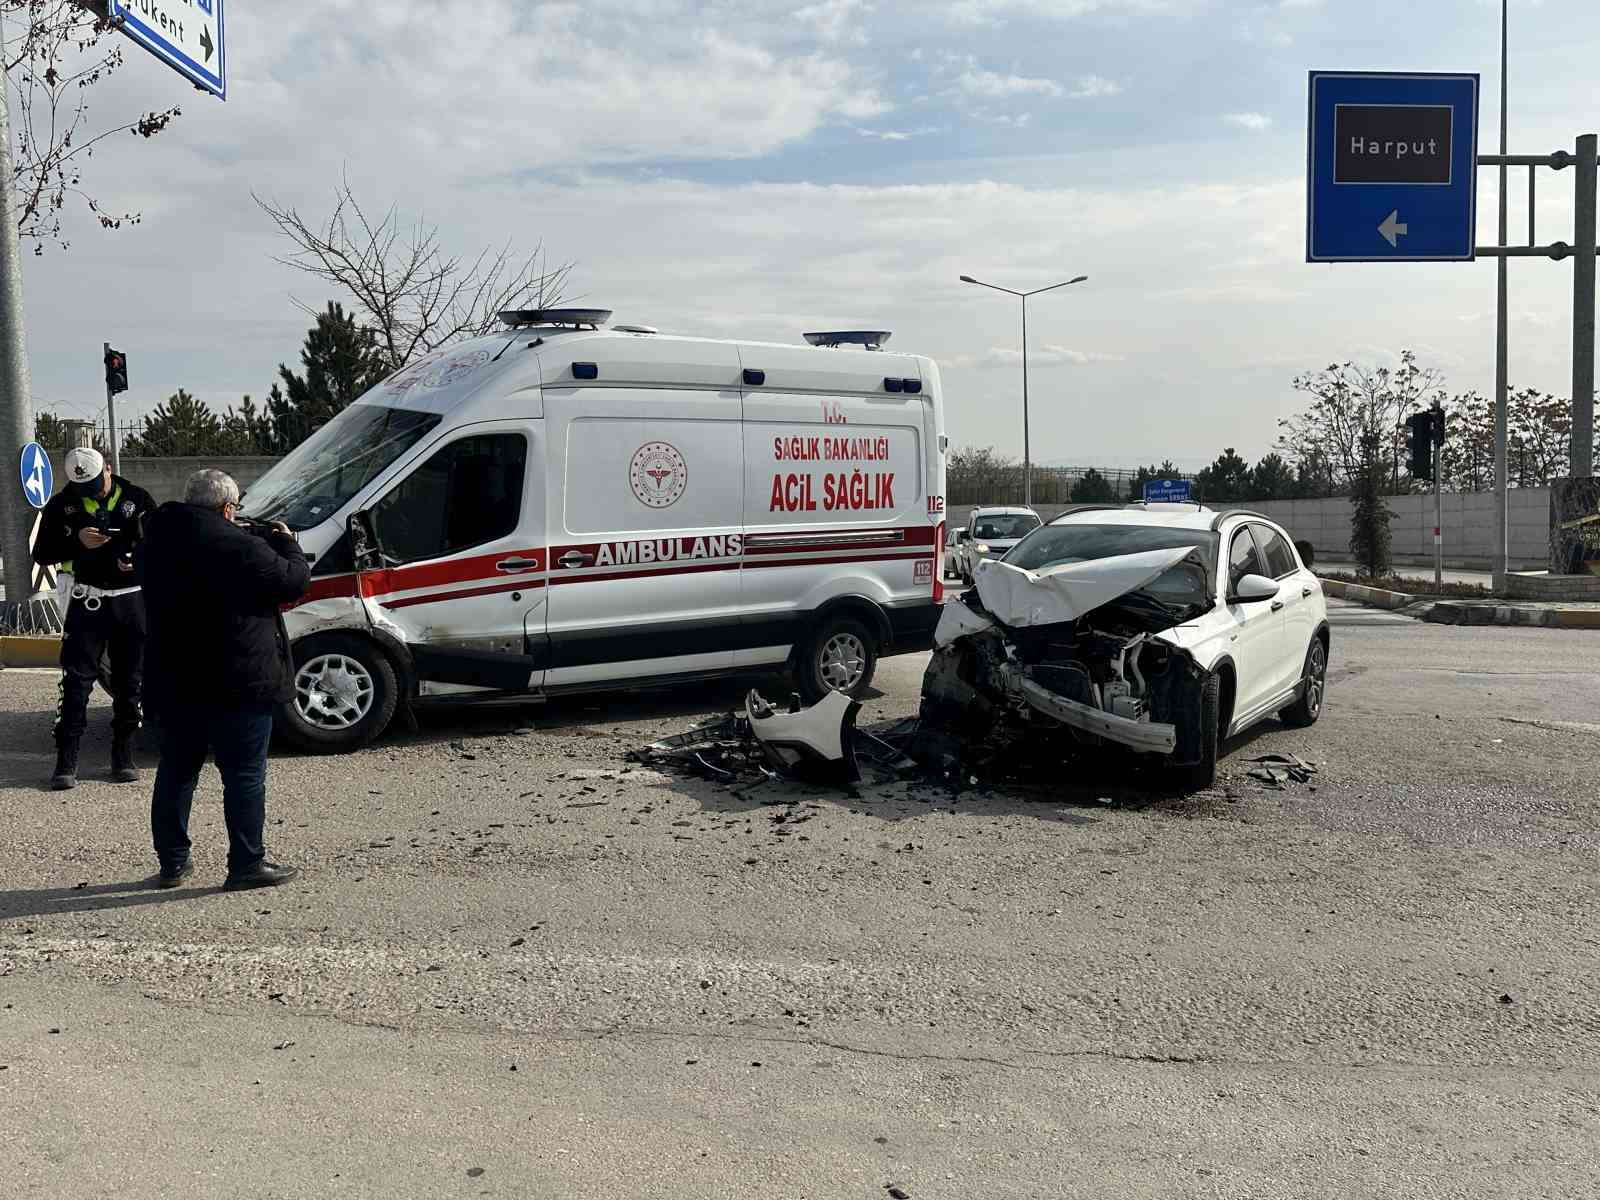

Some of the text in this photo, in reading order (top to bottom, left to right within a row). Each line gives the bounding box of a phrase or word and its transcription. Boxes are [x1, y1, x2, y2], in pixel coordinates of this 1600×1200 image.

[1351, 136, 1437, 159] Harput
[821, 400, 848, 424] T.C.
[774, 435, 889, 461] SAĞLIK BAKANLIĞI
[823, 467, 895, 511] SAĞLIK
[927, 495, 944, 511] 112
[594, 534, 742, 566] AMBULANS
[915, 562, 931, 576] 112
